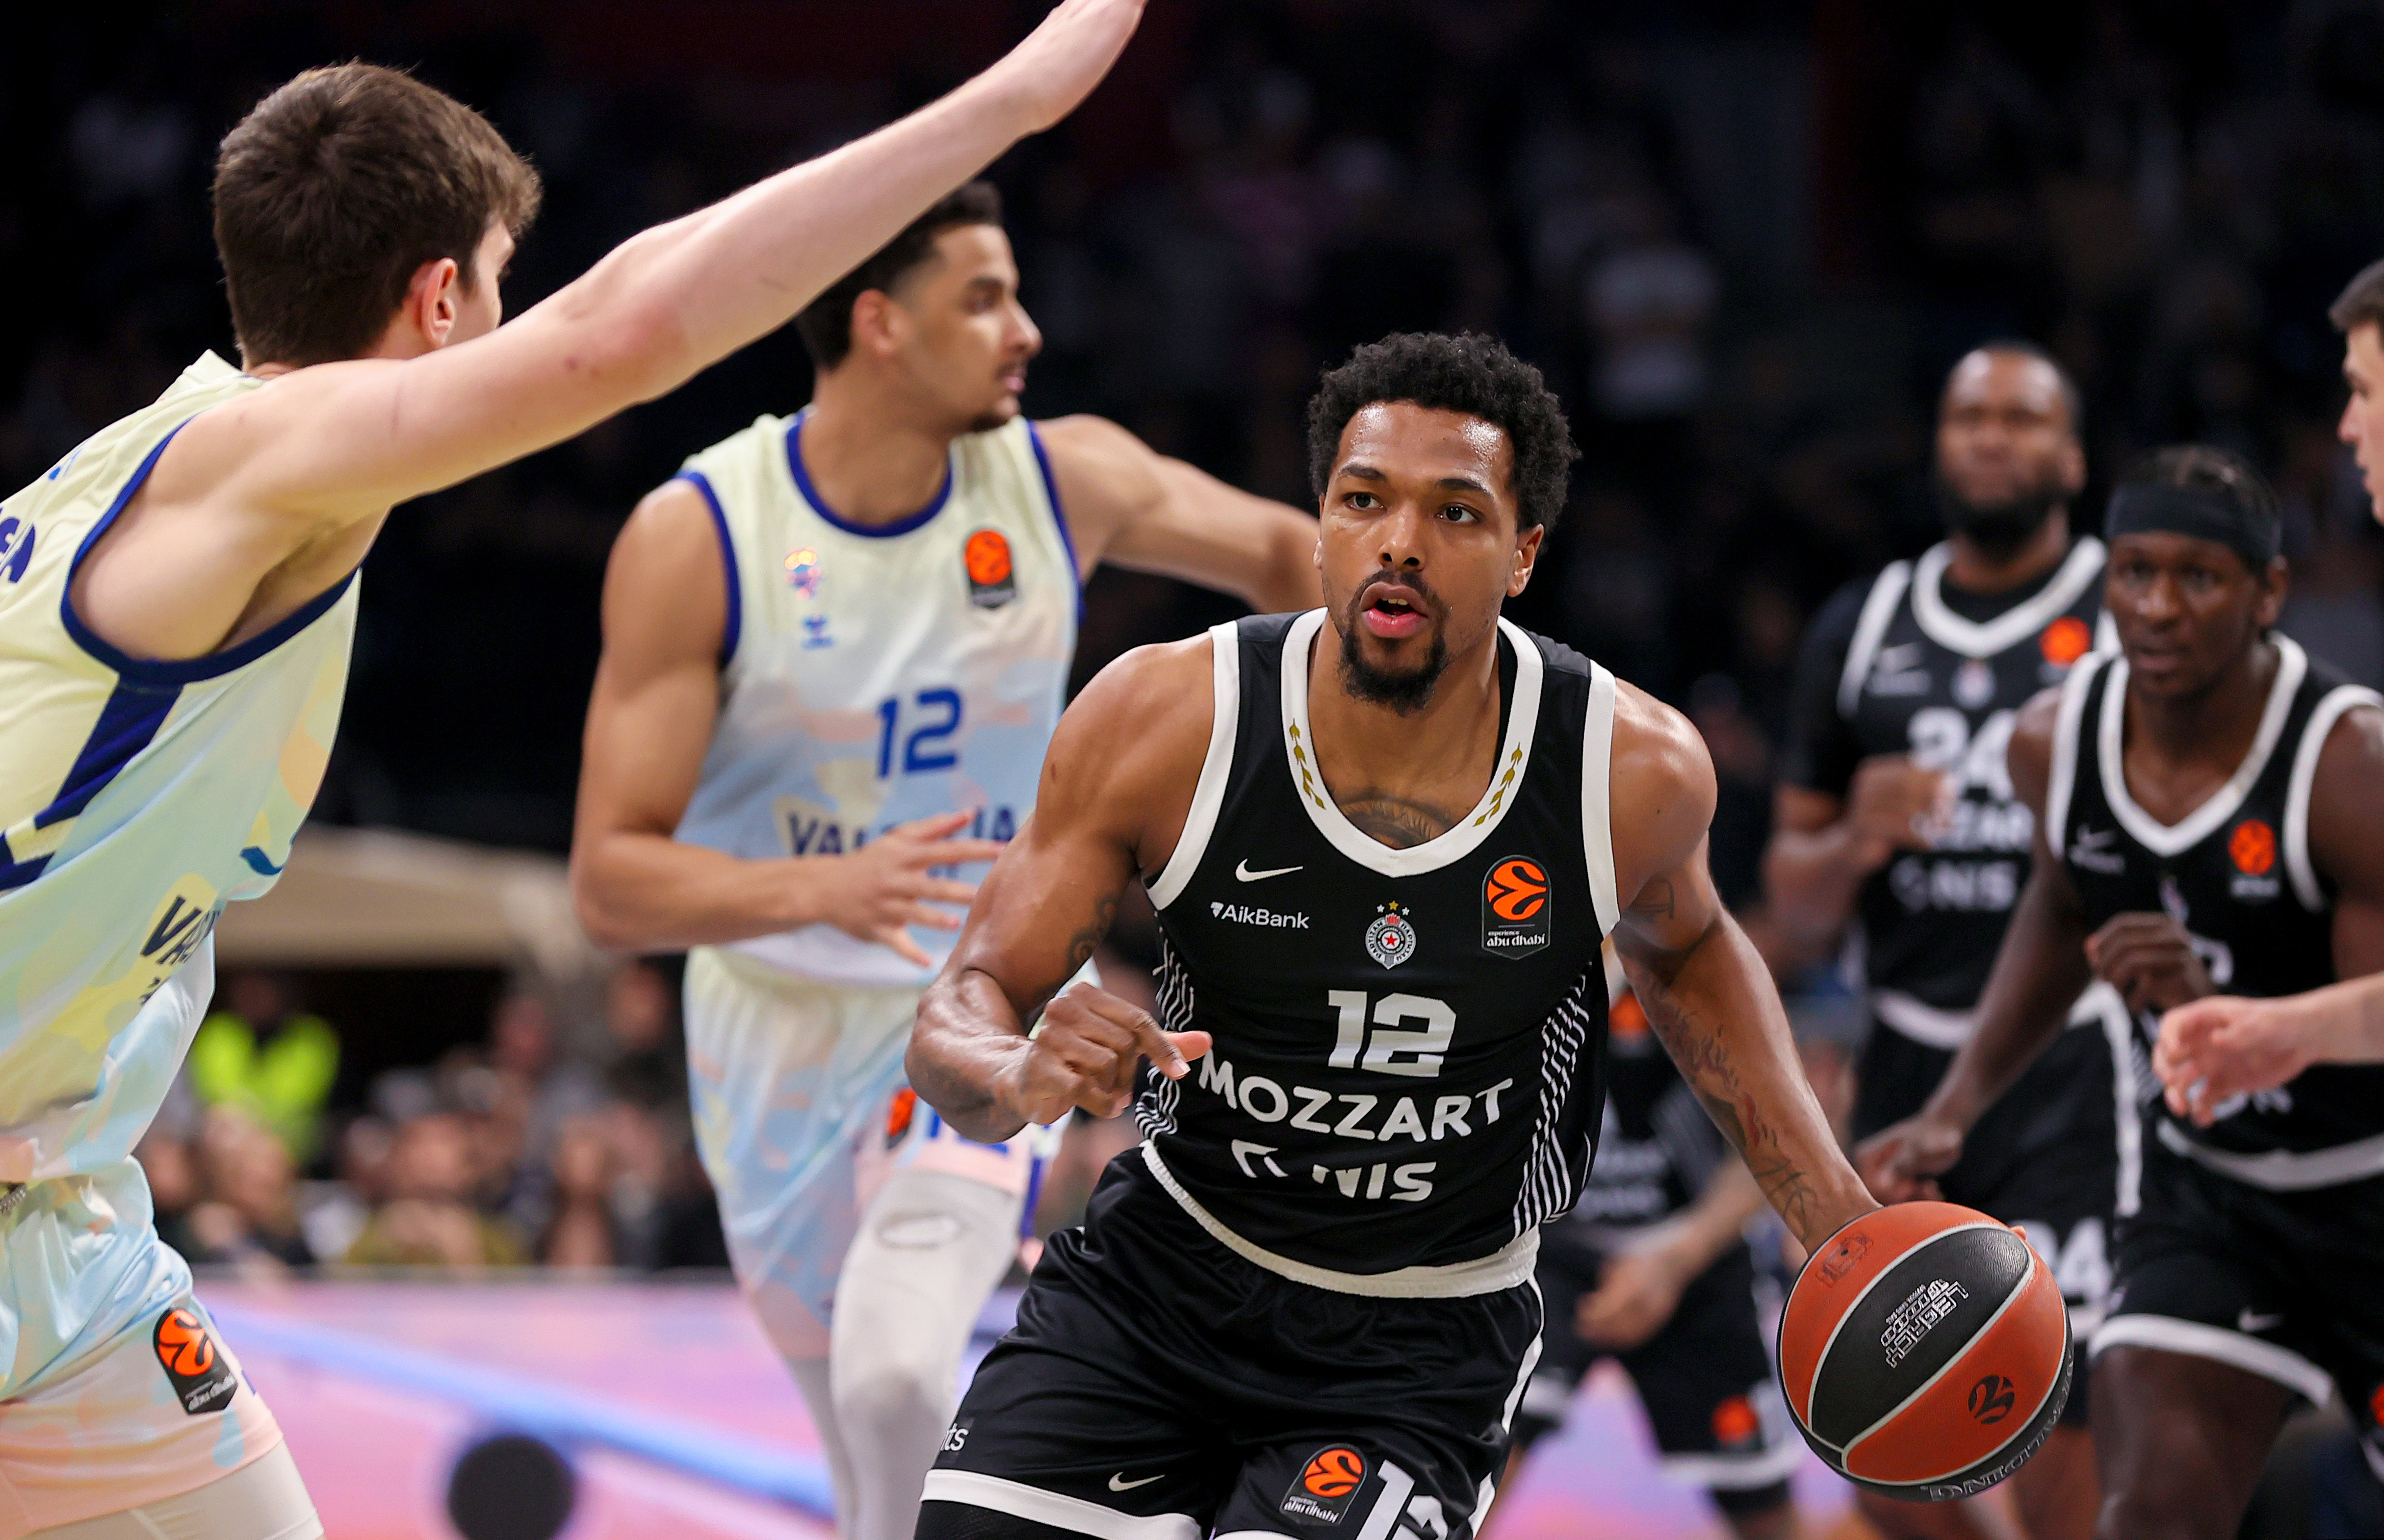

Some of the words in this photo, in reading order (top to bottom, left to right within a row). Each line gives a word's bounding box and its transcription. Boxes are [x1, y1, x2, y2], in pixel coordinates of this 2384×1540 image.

[877, 688, 962, 778] 12
[1221, 904, 1310, 929] AikBank
[1487, 936, 1509, 947] abu
[1511, 933, 1545, 946] dhabi
[1328, 990, 1456, 1077] 12
[1198, 1049, 1513, 1142] MOZZART
[1885, 1280, 1969, 1369] LEGACY
